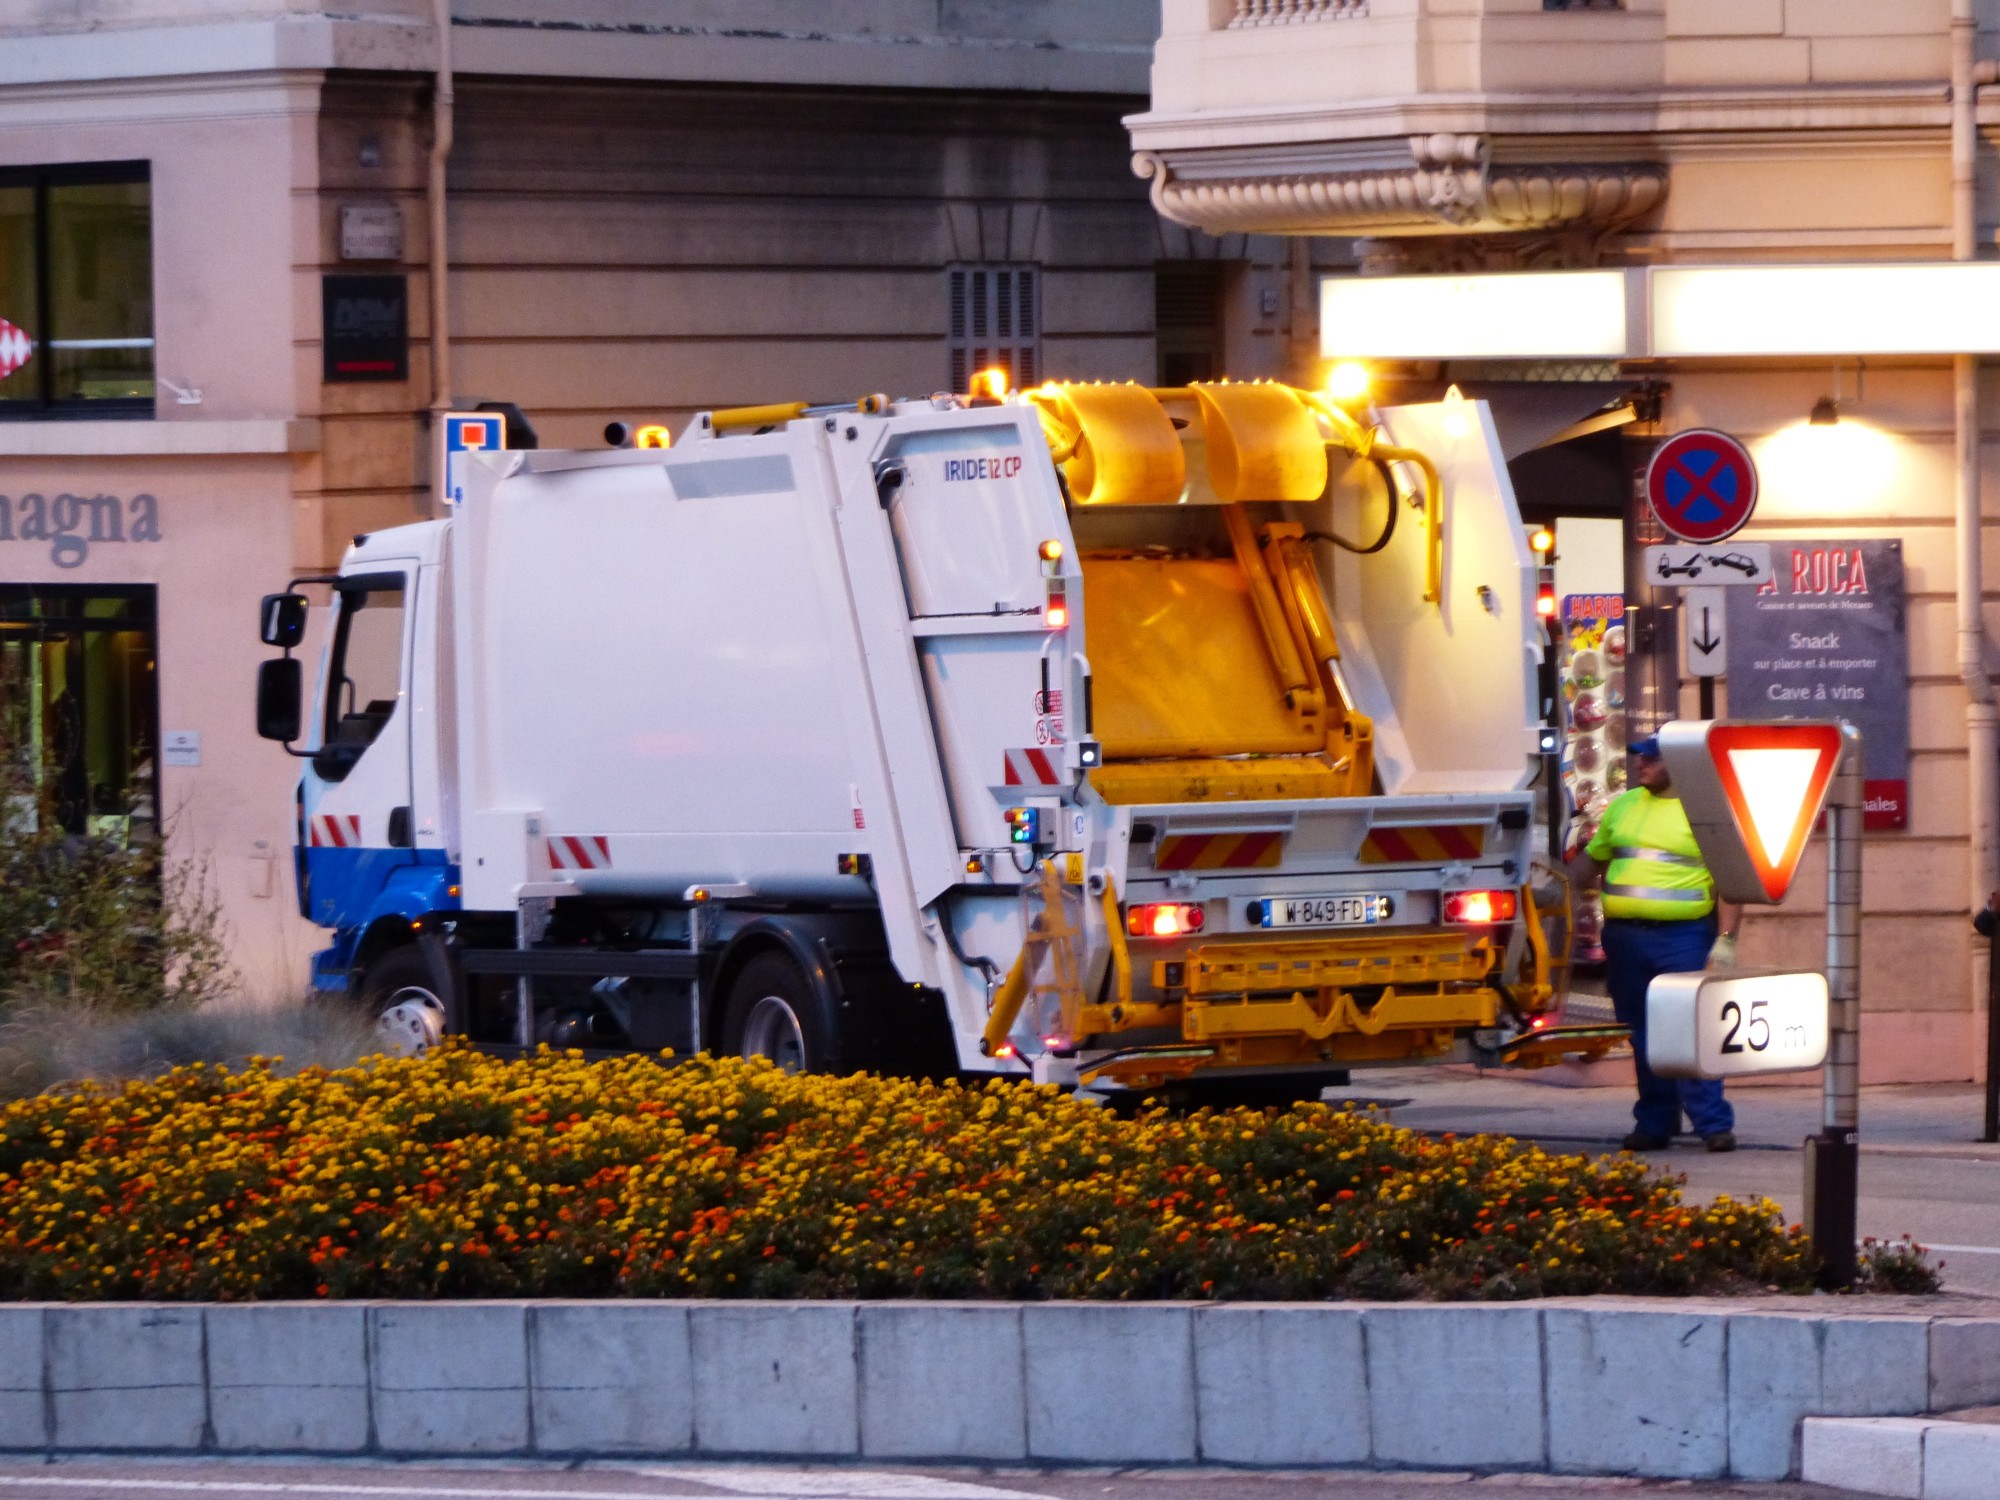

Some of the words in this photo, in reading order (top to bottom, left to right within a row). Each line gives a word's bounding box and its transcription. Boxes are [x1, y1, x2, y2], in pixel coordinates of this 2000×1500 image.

[1004, 456, 1022, 478] CP
[1792, 548, 1869, 595] ROCA
[1789, 632, 1840, 649] Snack
[1754, 661, 1770, 669] sur
[1774, 658, 1802, 671] place
[1804, 659, 1816, 669] et
[1829, 658, 1877, 671] emporter
[1767, 683, 1811, 700] Cave
[1832, 684, 1865, 700] vins
[1721, 1000, 1769, 1054] 25
[1784, 1025, 1806, 1048] m
